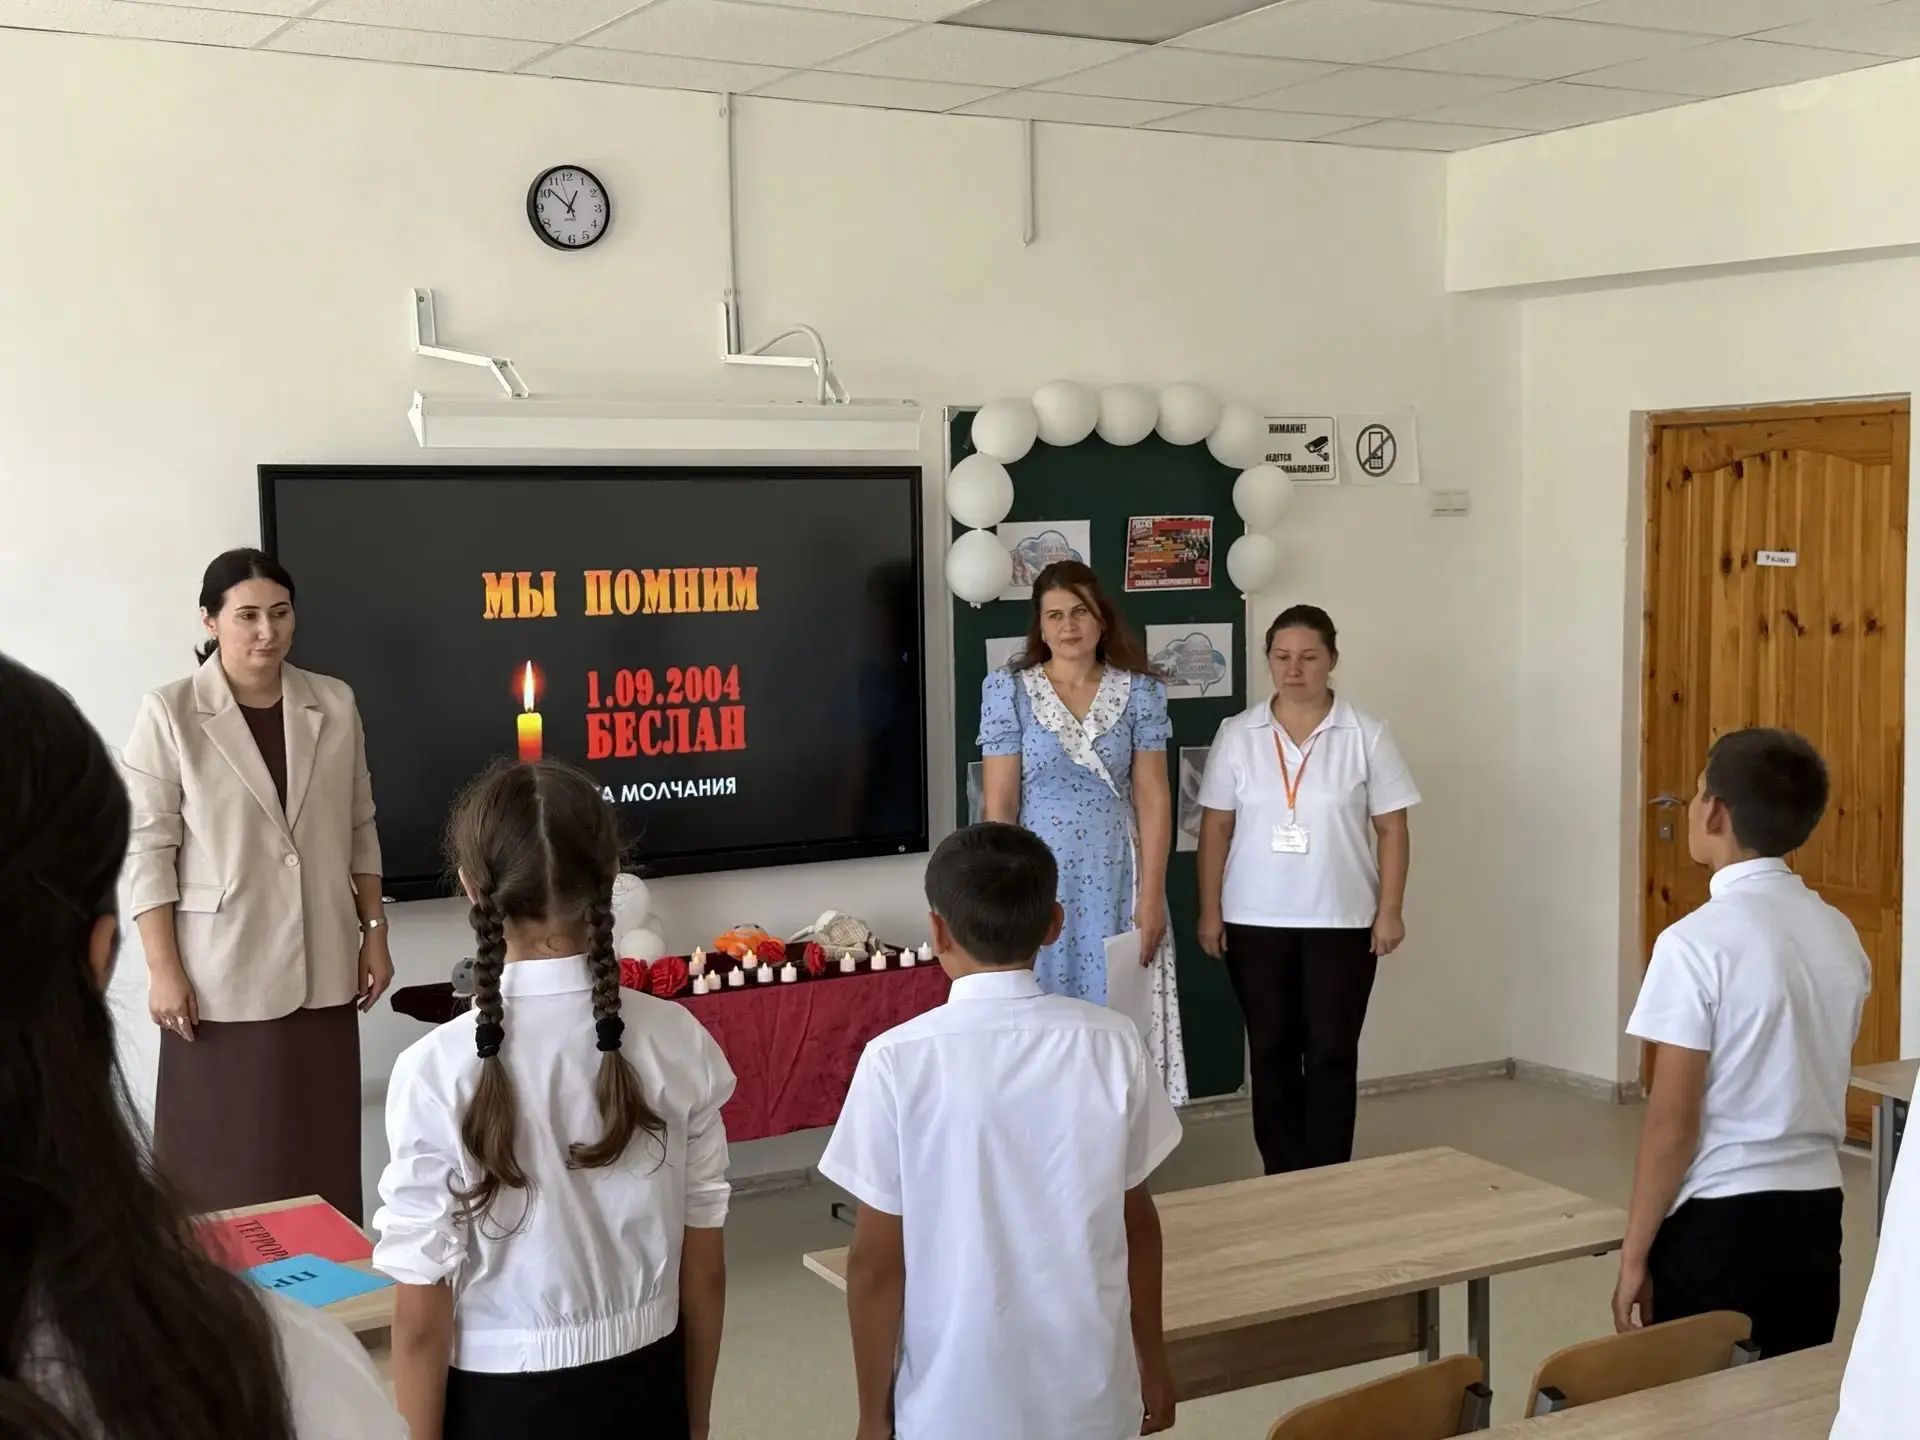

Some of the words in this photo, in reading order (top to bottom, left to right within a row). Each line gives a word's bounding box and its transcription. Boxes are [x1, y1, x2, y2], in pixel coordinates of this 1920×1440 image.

[549, 177, 559, 186] 11
[562, 173, 572, 181] 12
[590, 188, 597, 198] 2
[537, 203, 544, 213] 9
[594, 204, 602, 213] 3
[542, 219, 551, 228] 8
[590, 219, 597, 229] 4
[554, 230, 561, 241] 7
[568, 234, 576, 244] 6
[582, 231, 590, 240] 5
[1268, 424, 1307, 434] НИМАНИЕ!
[482, 571, 558, 619] МЫ
[583, 567, 760, 616] ПОМНИМ
[587, 664, 741, 708] 1.09.2004
[586, 706, 747, 760] БЕСЛАН
[621, 777, 737, 803] МОЛЧАНИЯ
